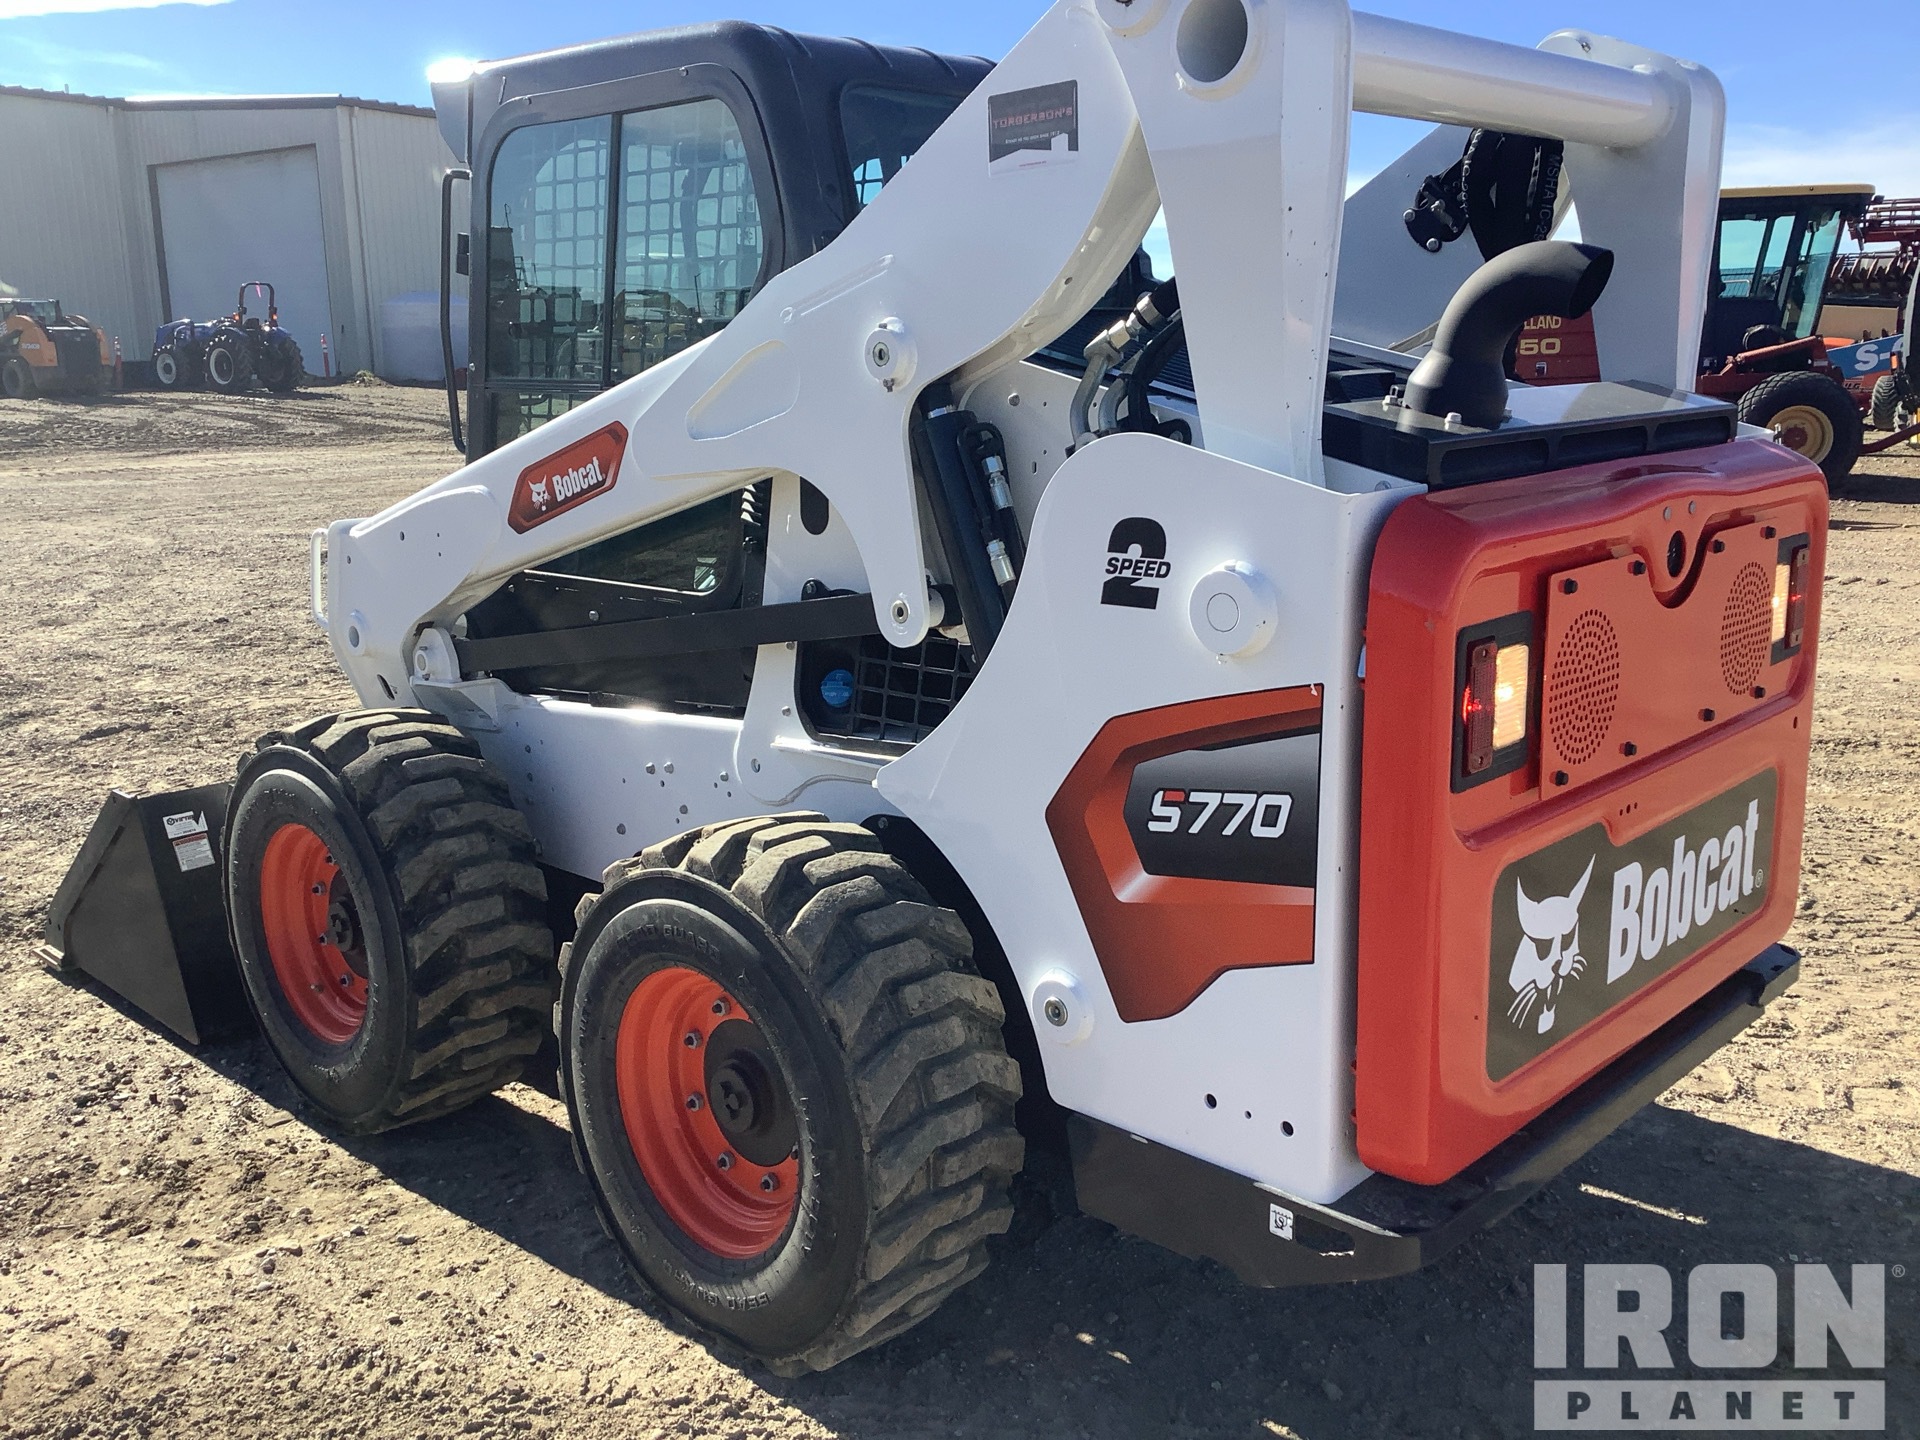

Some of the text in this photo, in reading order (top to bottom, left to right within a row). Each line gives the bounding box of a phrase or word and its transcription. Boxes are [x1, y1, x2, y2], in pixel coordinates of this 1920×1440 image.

[552, 456, 603, 502] Bobcat
[1100, 517, 1167, 610] 2
[1105, 556, 1171, 579] SPEED
[1147, 790, 1293, 838] S770
[1606, 798, 1759, 985] Bobcat
